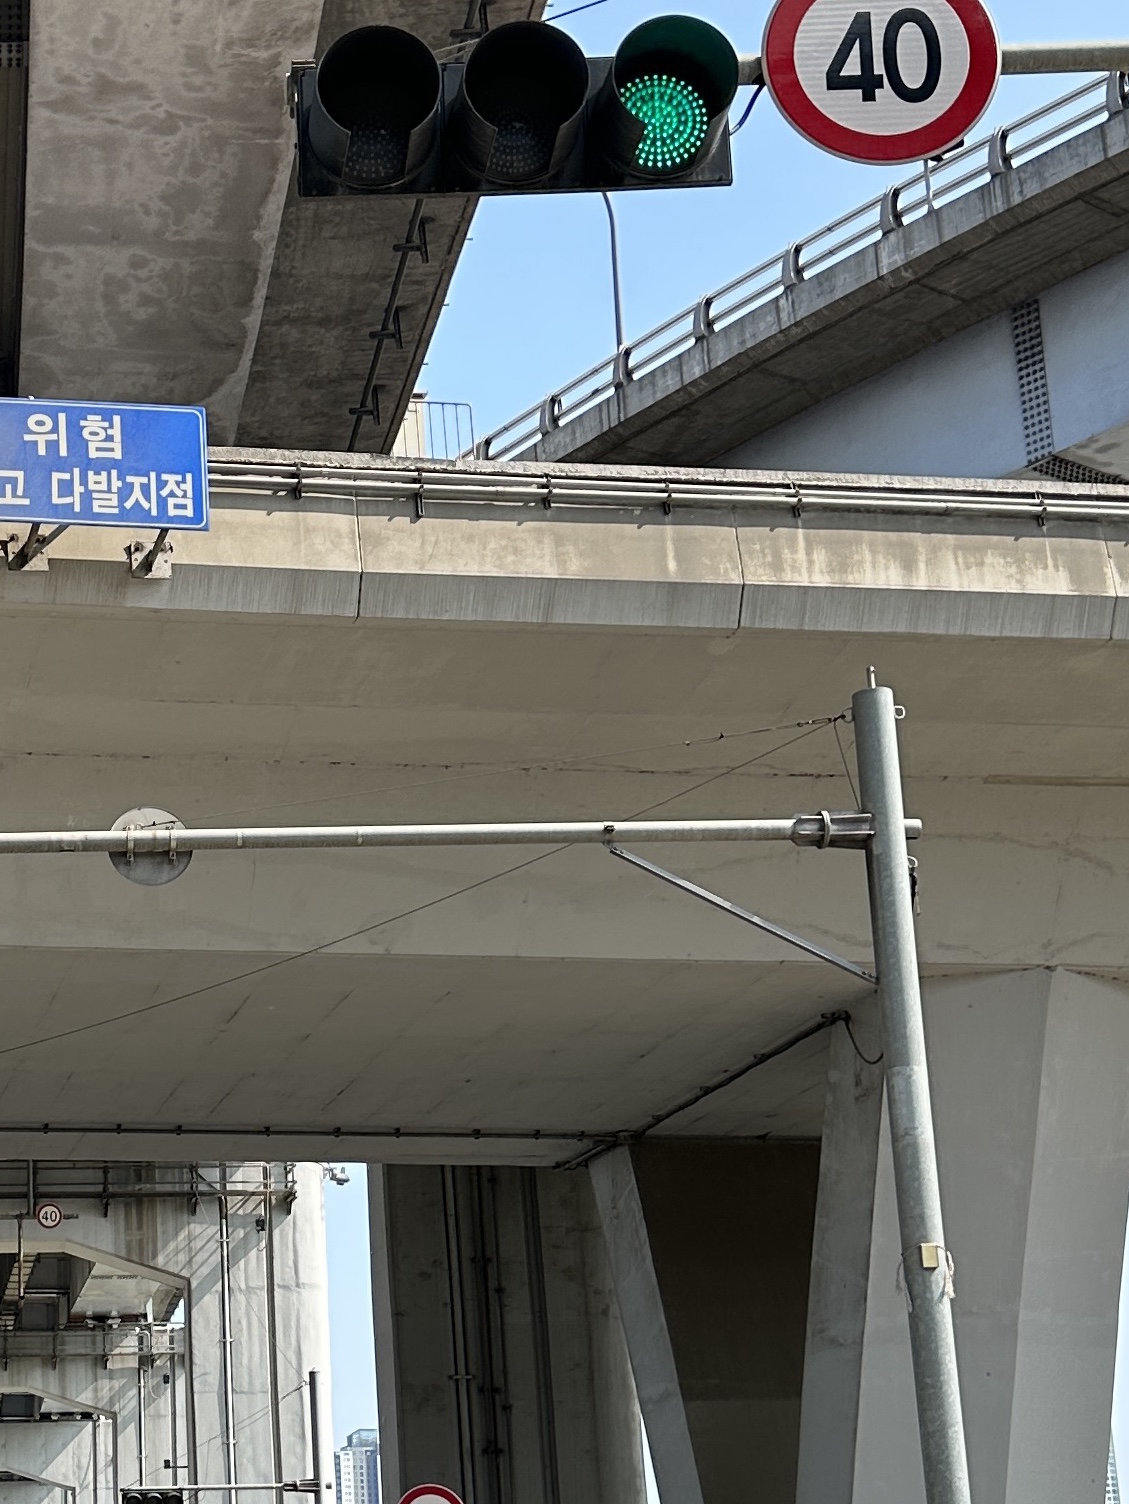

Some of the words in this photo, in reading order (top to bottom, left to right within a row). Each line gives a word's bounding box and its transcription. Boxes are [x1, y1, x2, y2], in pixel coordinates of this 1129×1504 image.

[825, 7, 942, 103] 40
[51, 467, 194, 518] 다발지점
[41, 1210, 57, 1222] 40
